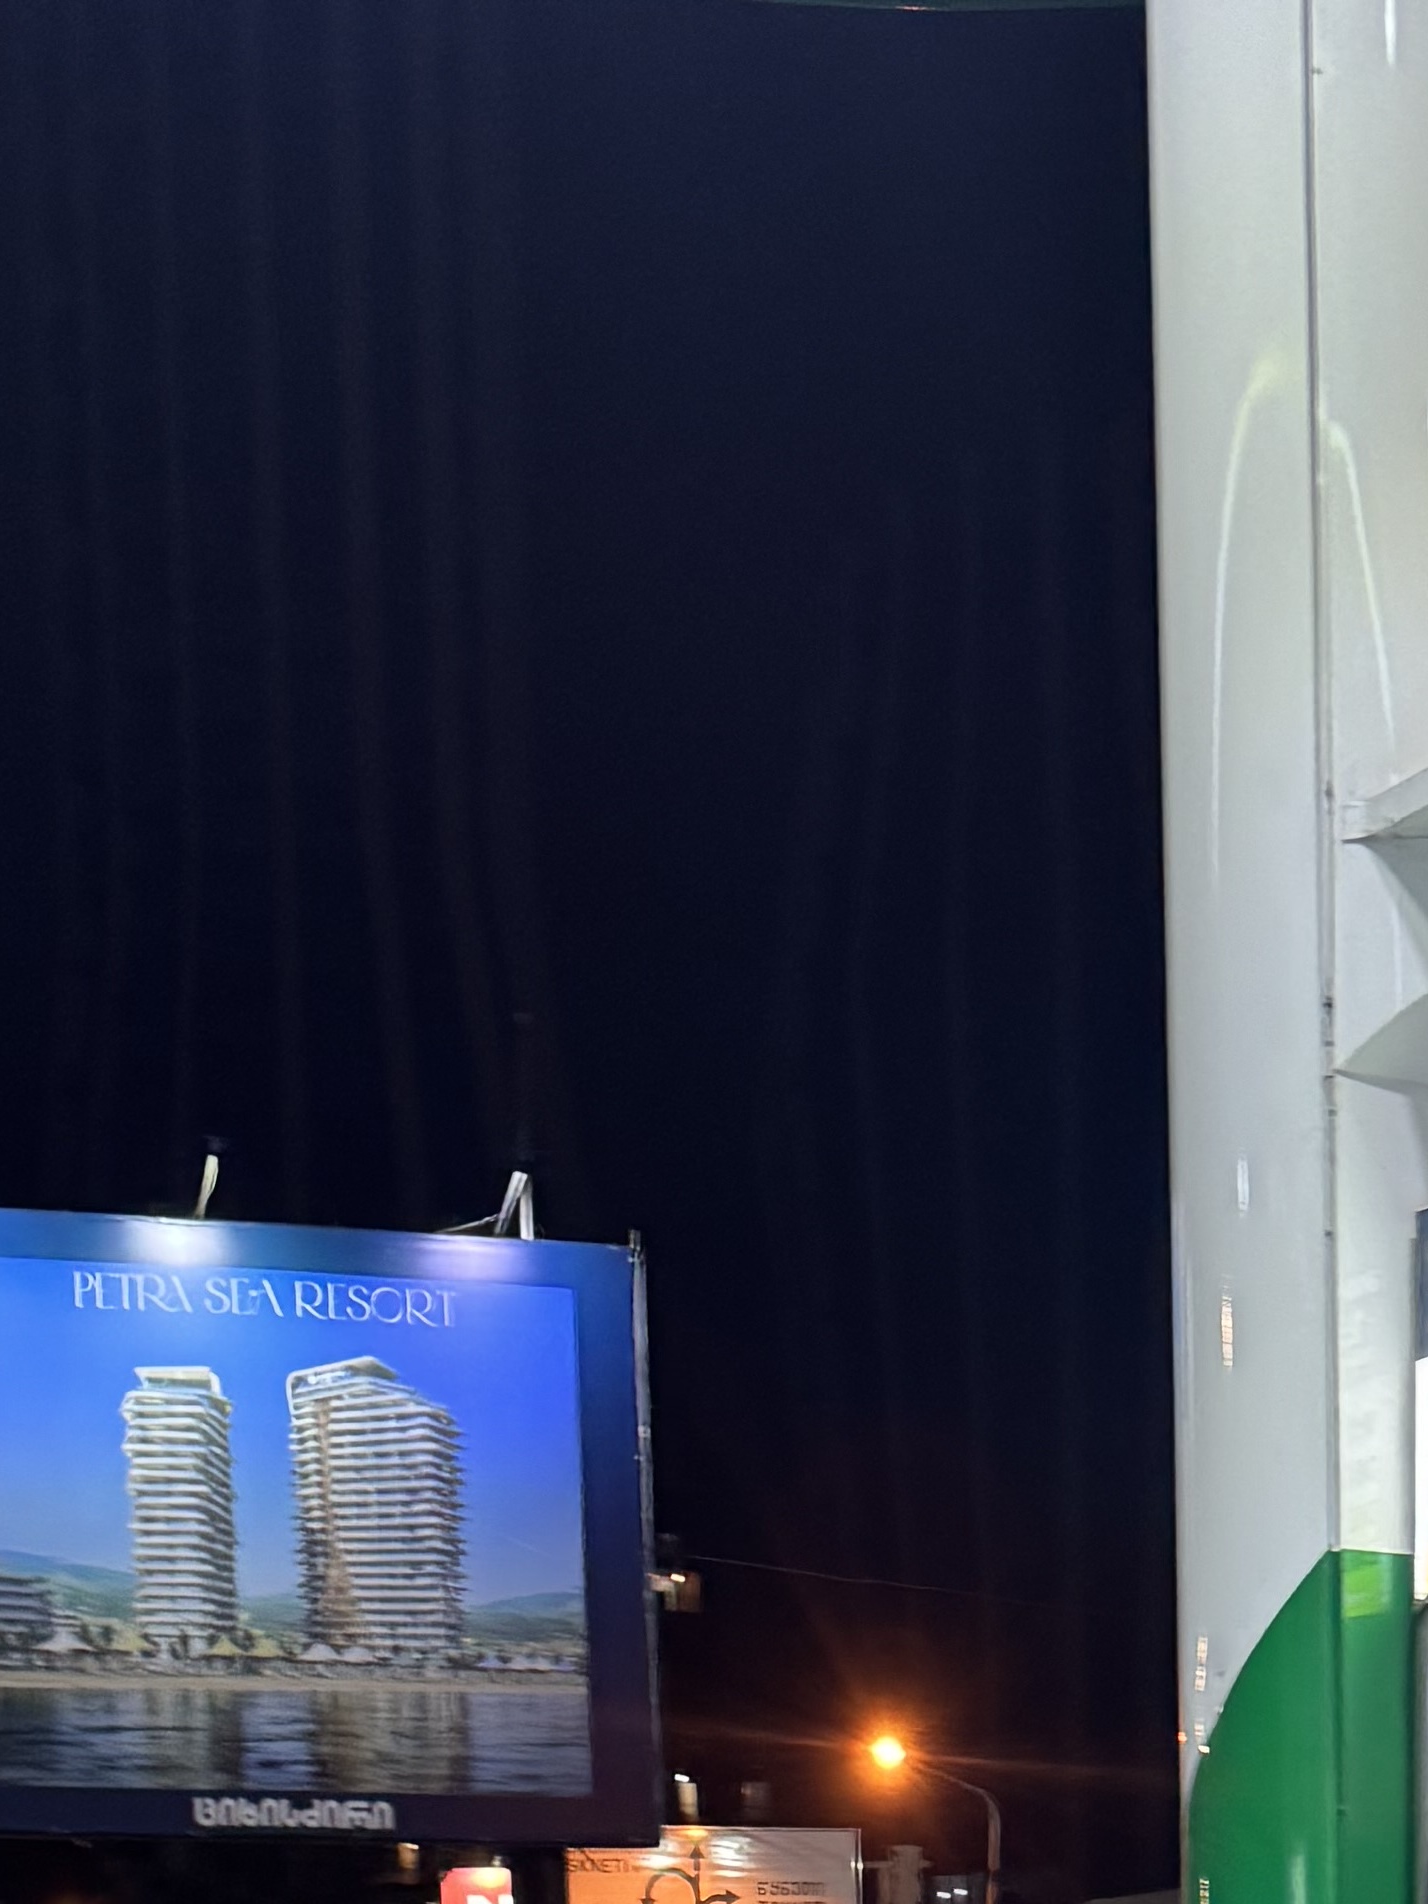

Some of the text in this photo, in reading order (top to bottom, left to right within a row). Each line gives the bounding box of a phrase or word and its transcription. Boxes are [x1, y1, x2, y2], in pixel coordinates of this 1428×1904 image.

[73, 1271, 456, 1328] PETRA SEA RESORT
